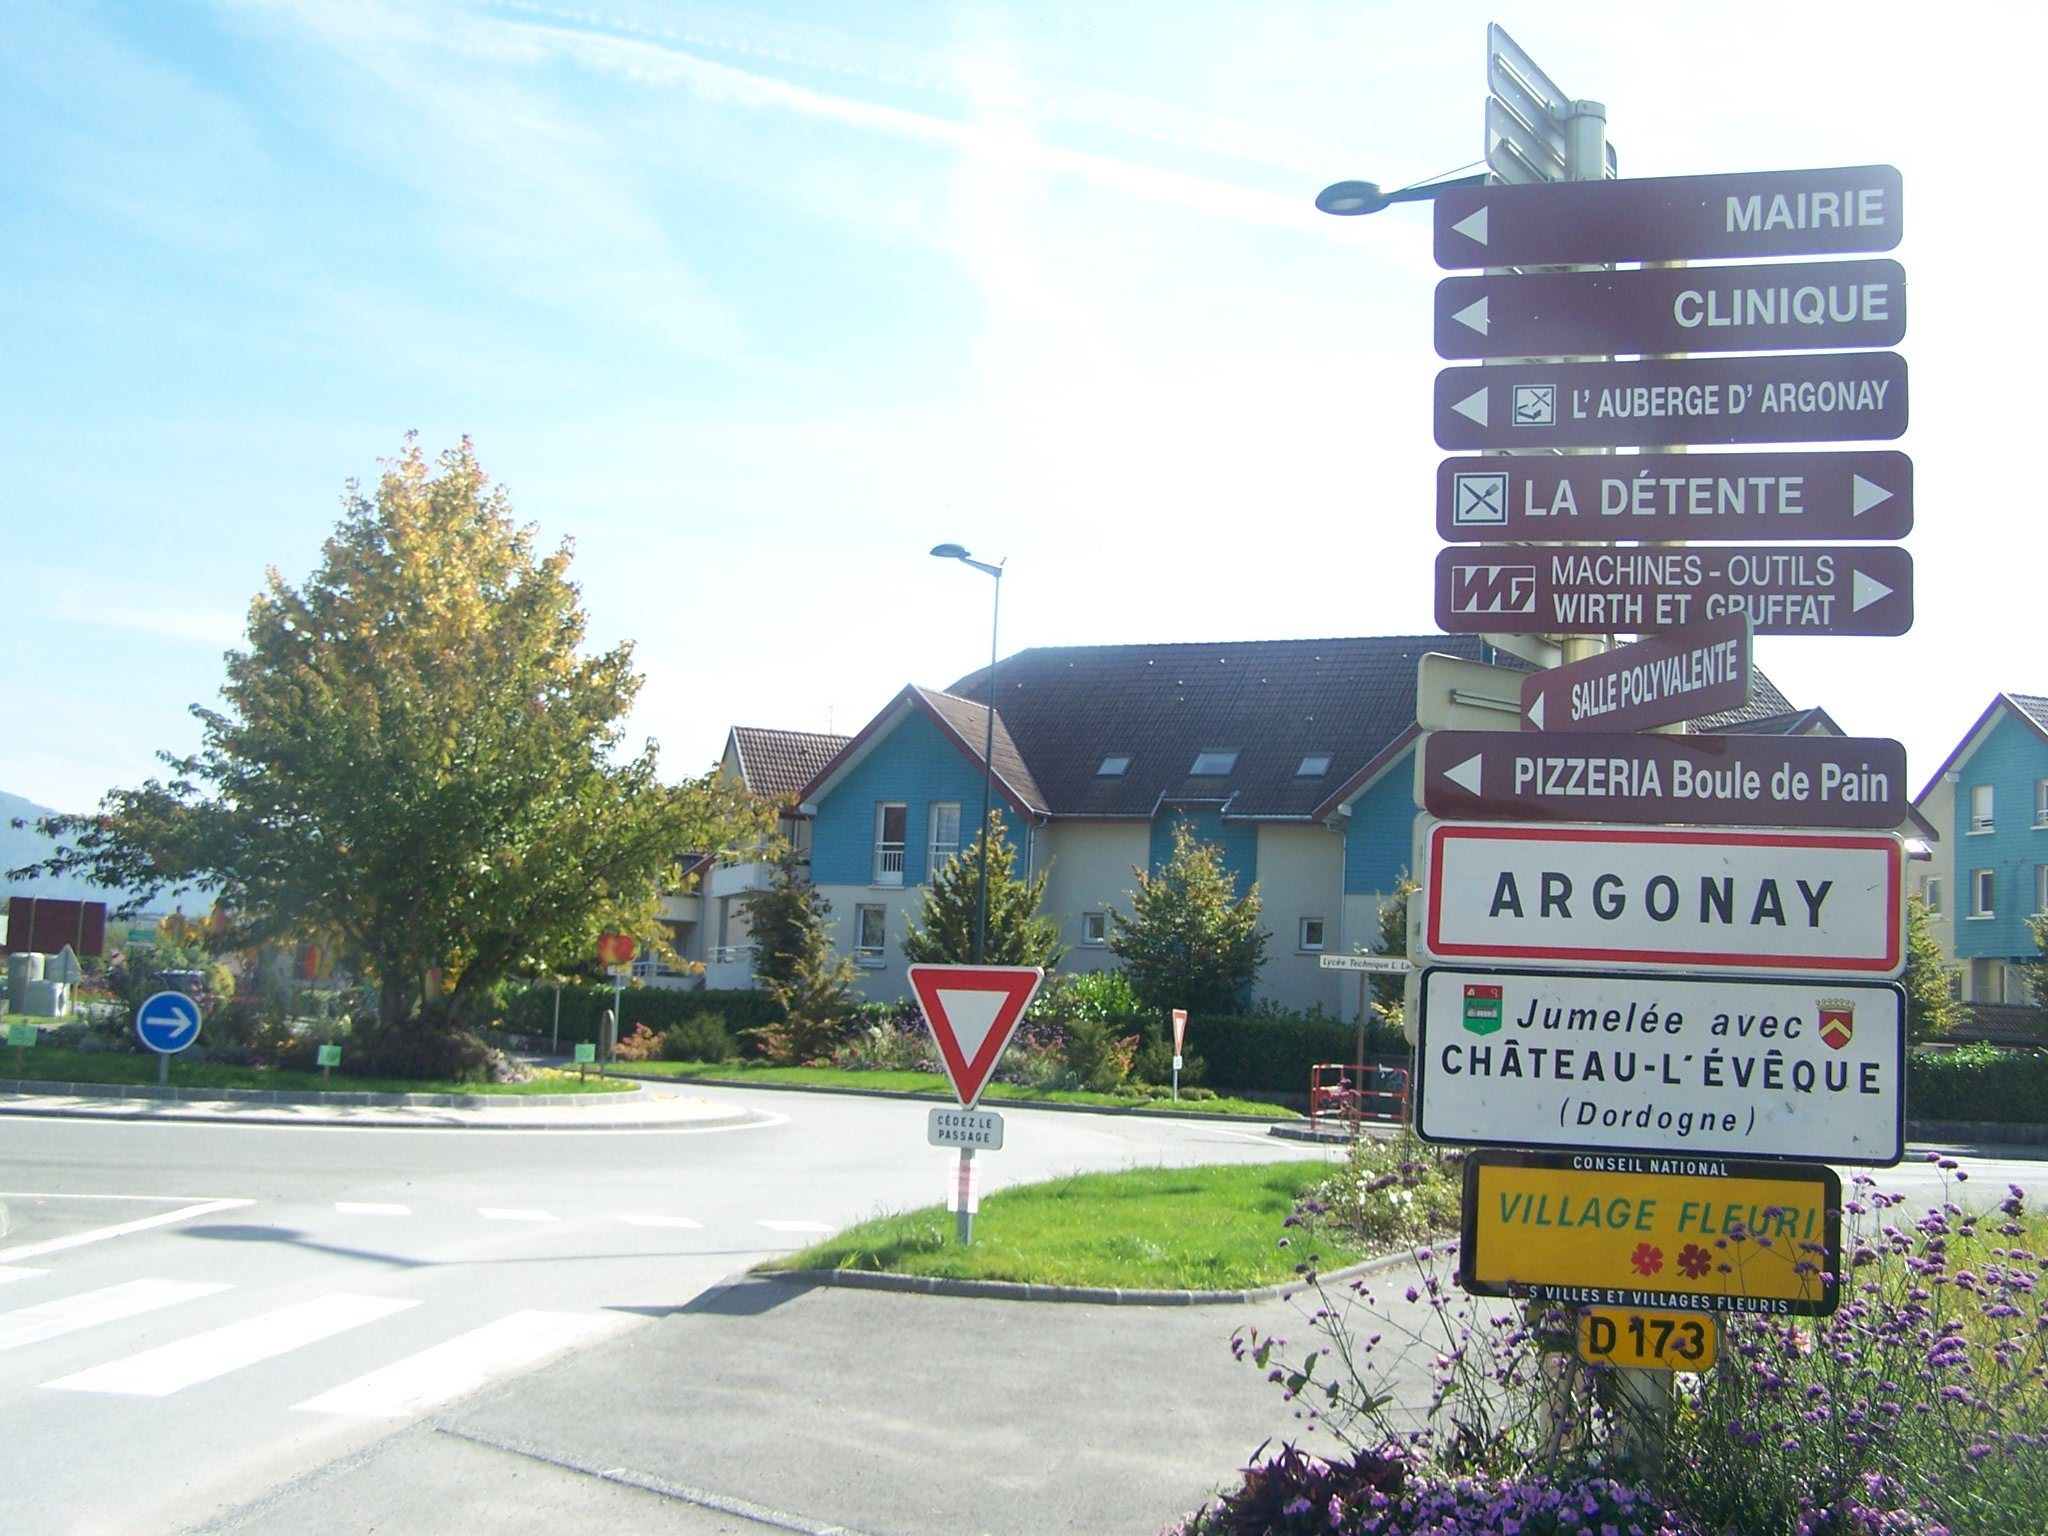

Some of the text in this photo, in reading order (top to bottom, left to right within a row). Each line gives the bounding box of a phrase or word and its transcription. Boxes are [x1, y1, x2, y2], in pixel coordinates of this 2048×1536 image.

[1725, 189, 1884, 232] MAIRIE
[1674, 283, 1889, 328] CLINIQUE
[1597, 385, 1719, 418] AUBERGE
[1761, 380, 1890, 413] ARGONAY
[1524, 470, 1804, 516] LA DÉTENTE
[1553, 594, 1643, 624] WIRTH
[1656, 594, 1691, 624] ET
[1571, 639, 1738, 722] SALLE POLYVALENTE
[1515, 757, 1889, 802] PIZZERIA Boule de Pain
[1489, 872, 1834, 928] ARGONAY
[1323, 958, 1346, 968] Lycée
[1349, 959, 1389, 971] Technique
[1516, 999, 1803, 1039] Jumelée avec
[938, 1115, 992, 1128] CÉDEZ LE
[939, 1130, 989, 1142] PASSAGE
[1559, 1097, 1757, 1136] (Dordogne)
[1573, 1156, 1728, 1177] CONSEIL NATIONAL
[1499, 1193, 1816, 1239] VILLAGE FLEURI
[1545, 1286, 1600, 1303] VILLES
[1606, 1290, 1625, 1304] ET
[1633, 1291, 1708, 1310] VILLAGES
[1717, 1296, 1789, 1314] FLEURIS
[1589, 1317, 1705, 1360] D 173
